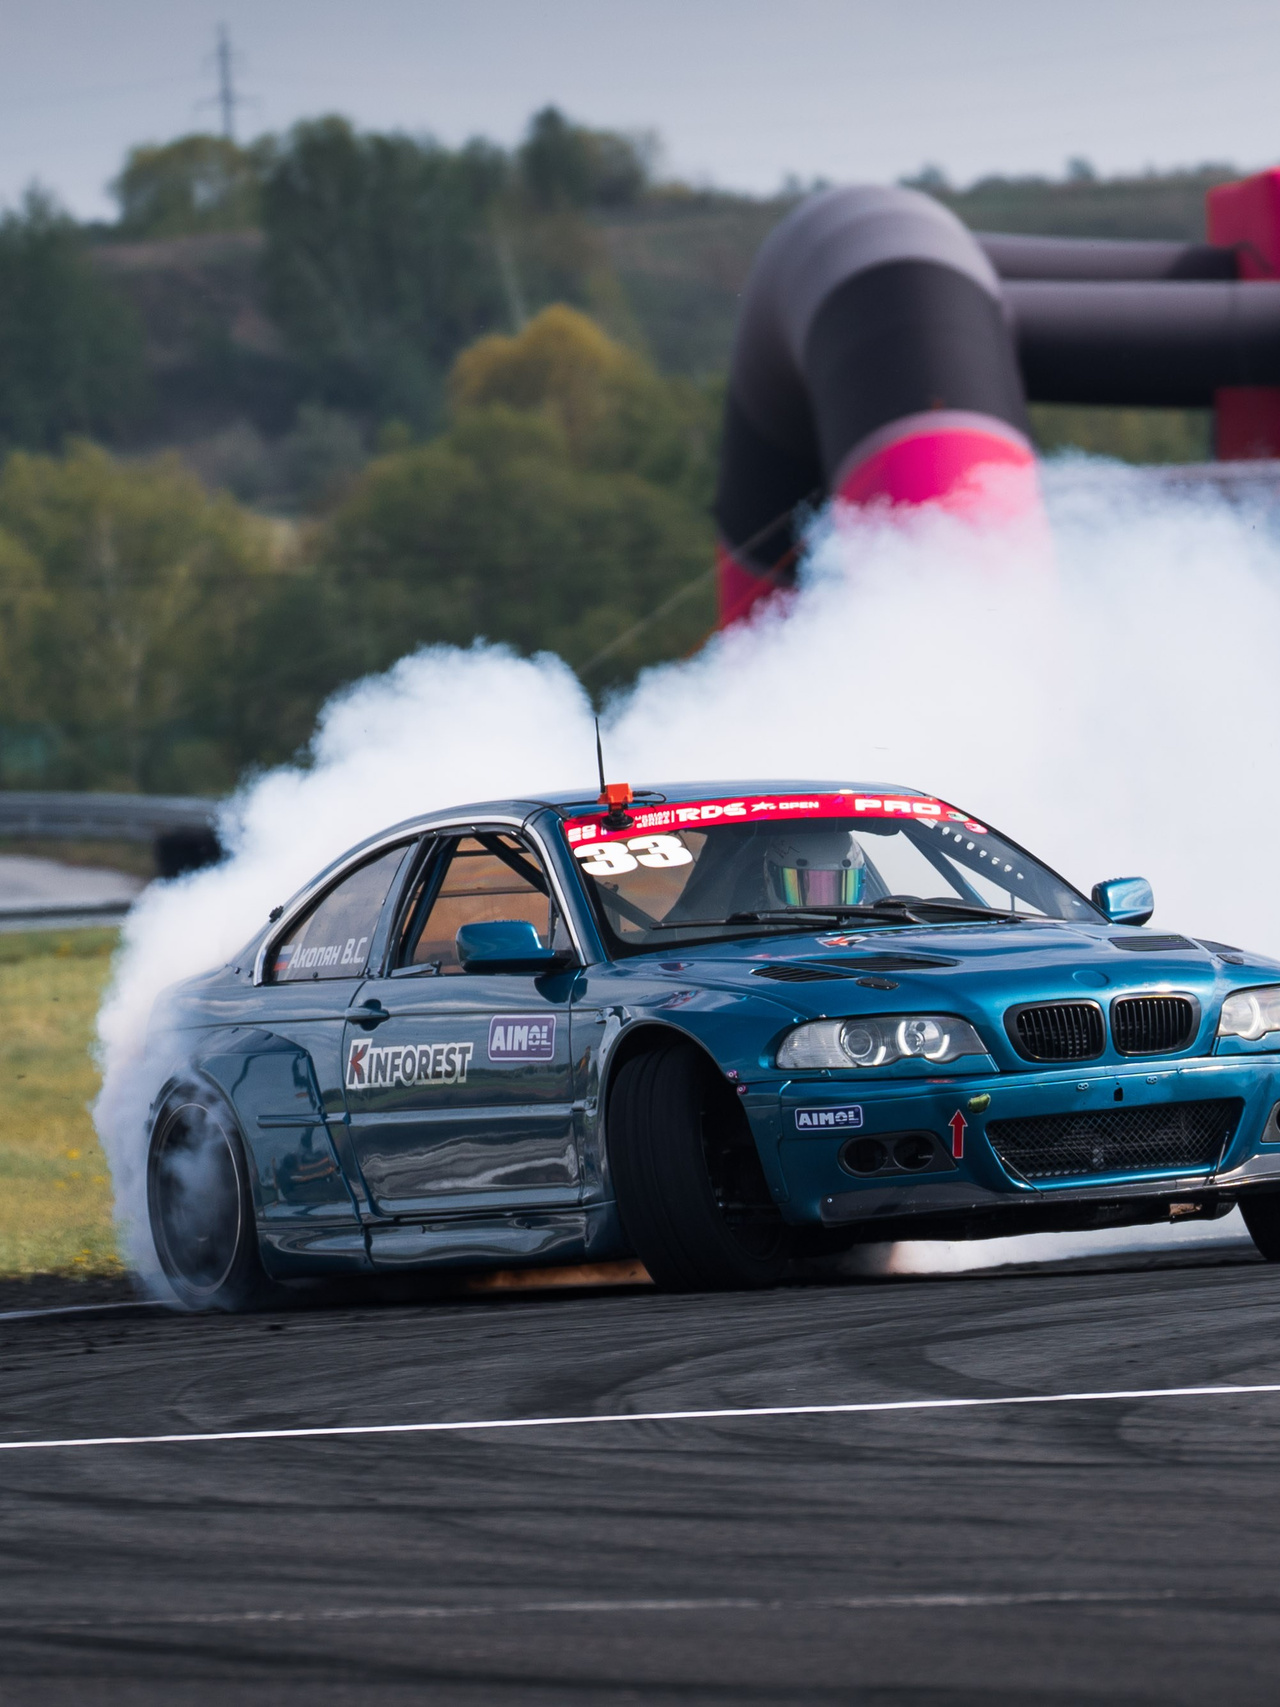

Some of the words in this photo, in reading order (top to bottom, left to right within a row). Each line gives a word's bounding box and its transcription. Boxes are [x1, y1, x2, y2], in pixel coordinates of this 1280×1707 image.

[779, 801, 819, 810] OPEN
[854, 798, 941, 815] PRO
[574, 834, 693, 876] 33
[490, 1025, 551, 1052] AIMOL
[348, 1041, 472, 1087] KINFOREST
[798, 1110, 859, 1126] AIMOL
